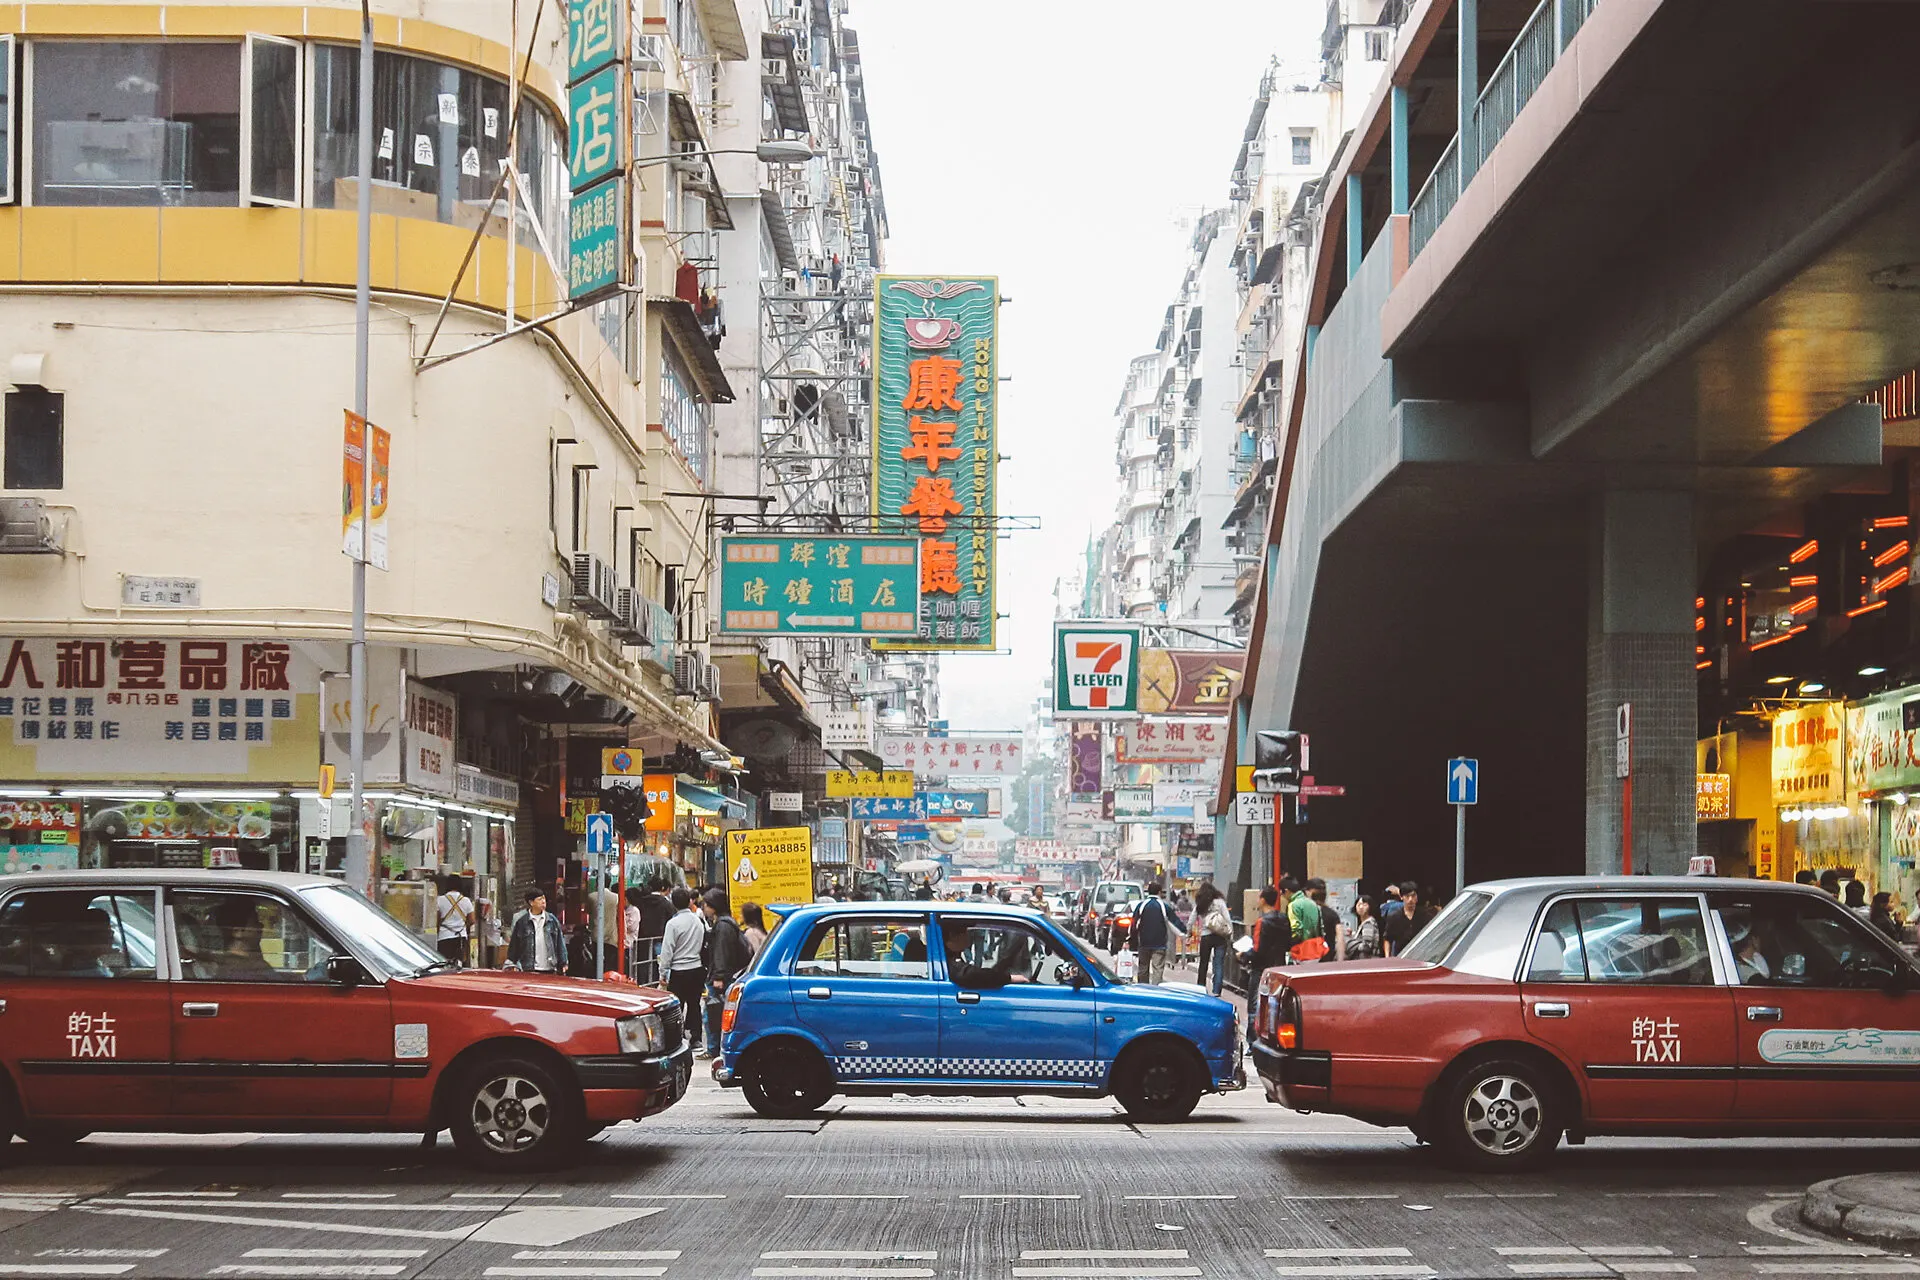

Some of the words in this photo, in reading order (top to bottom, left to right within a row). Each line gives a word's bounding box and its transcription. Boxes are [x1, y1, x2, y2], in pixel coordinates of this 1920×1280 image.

[442, 100, 457, 118] 新
[380, 135, 392, 150] 正
[418, 142, 432, 159] 宗
[974, 337, 990, 393] HONG
[974, 399, 989, 441] LIN
[901, 355, 964, 594] 康年餐廳
[973, 448, 989, 594] RESTAURANT
[789, 541, 852, 569] 輝煌
[743, 576, 897, 607] 時鐘酒店
[1076, 642, 1122, 707] 7
[21, 720, 120, 740] 傳統製作
[954, 799, 974, 811] City
[1243, 796, 1257, 805] 24
[1260, 796, 1275, 805] hr
[1698, 796, 1723, 812] 奶茶
[1246, 808, 1273, 821] 全日
[754, 842, 806, 855] 23348885
[68, 1012, 116, 1033] 的士
[1632, 1016, 1680, 1039] 的士
[66, 1035, 117, 1057] TAXI
[1631, 1040, 1681, 1062] TAXI
